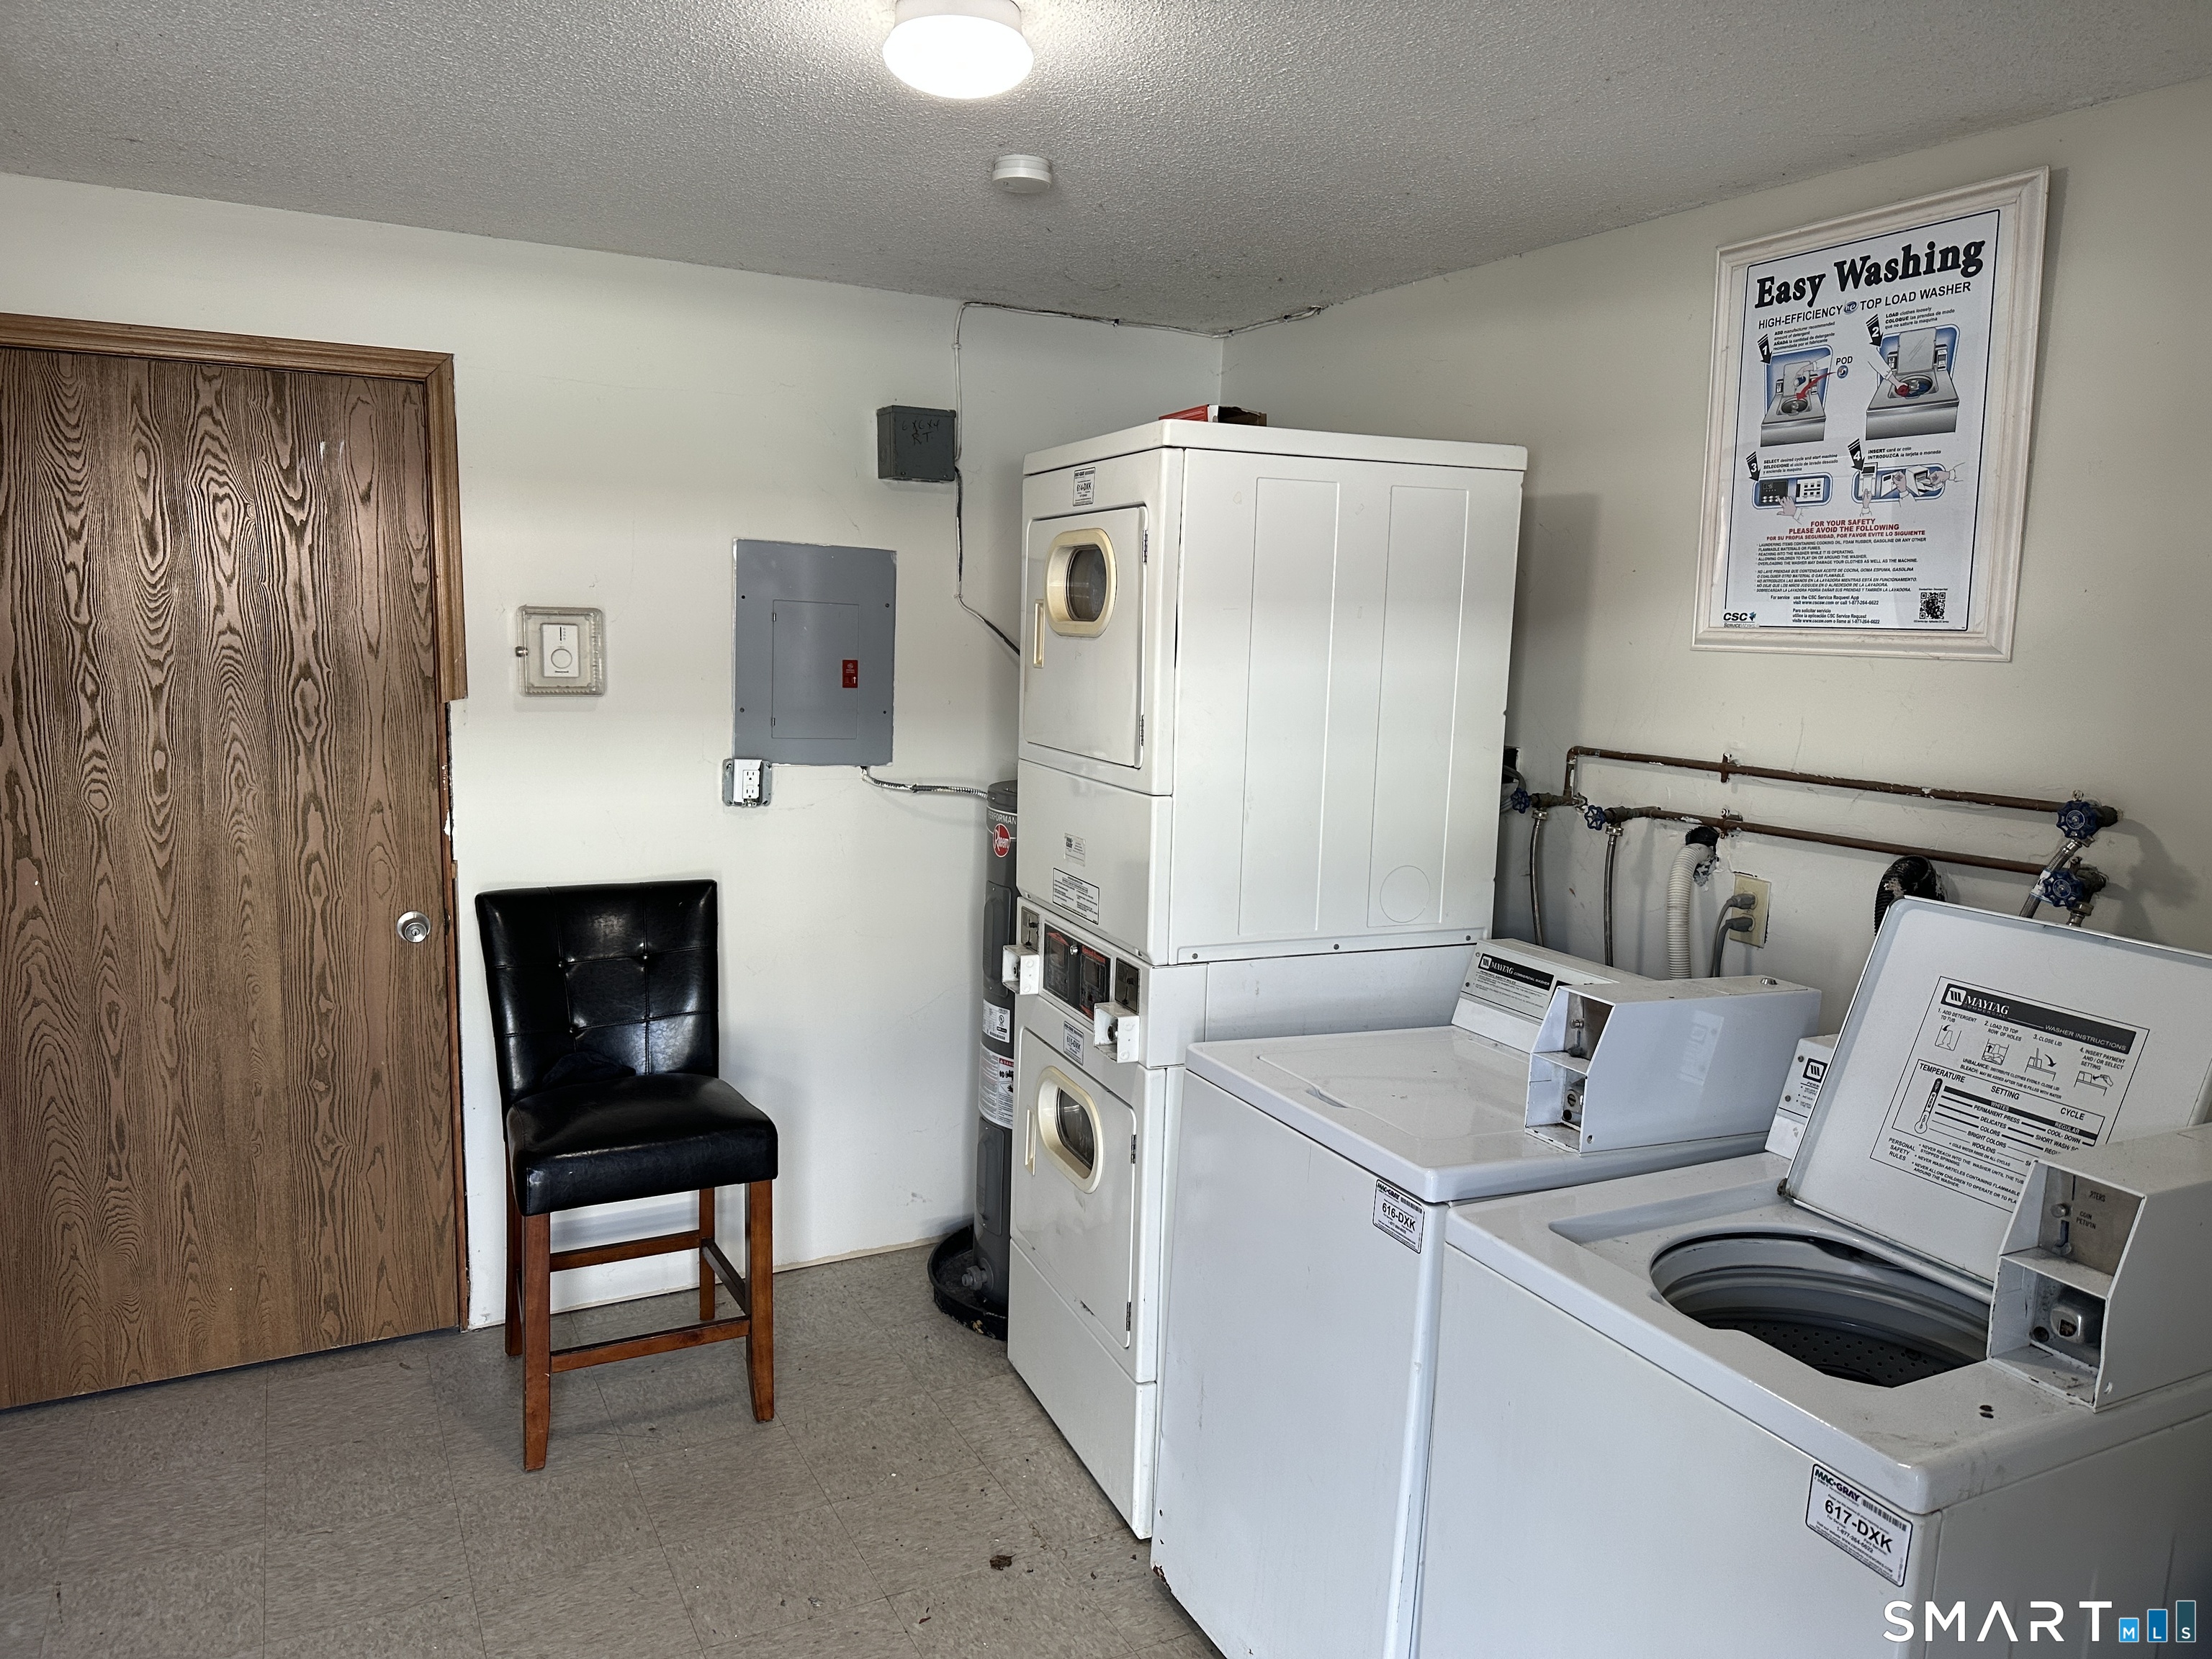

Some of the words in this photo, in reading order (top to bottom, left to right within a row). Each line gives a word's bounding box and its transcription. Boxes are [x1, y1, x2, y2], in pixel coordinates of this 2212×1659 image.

[1755, 273, 1826, 309] Easy
[1833, 240, 1986, 292] Washing
[1758, 305, 1843, 330] HIGH-EFFICIENCY
[1860, 297, 1881, 310] TOP
[1885, 292, 1916, 306] LOAD
[1920, 282, 1971, 300] WASHER
[1871, 326, 1879, 338] 2
[1762, 346, 1767, 355] 1
[1835, 356, 1853, 366] POD
[1853, 451, 1861, 461] 4
[1751, 463, 1757, 472] 3
[1723, 612, 1748, 621] CSC
[1492, 962, 1514, 974] MAYTAG
[1965, 996, 2009, 1015] MAYTAG
[1951, 1012, 1977, 1022] DETERGENT
[2038, 1036, 2054, 1045] CLOSE
[2046, 1025, 2074, 1037] WASHER
[2075, 1033, 2126, 1051] INSTRUCTIONS
[2085, 1049, 2103, 1058] INSERT
[2103, 1054, 2126, 1064] PAYMENT
[2080, 1061, 2101, 1070] SETTING
[2104, 1061, 2124, 1070] SELECT
[1920, 1063, 1966, 1083] TEMPERATURE
[1991, 1086, 2020, 1100] SETTING
[1991, 1102, 2009, 1111] WHITES
[1974, 1105, 2003, 1118] PERMANENT
[2003, 1115, 2020, 1124] PRESS
[2060, 1107, 2085, 1120] CYCLE
[1980, 1116, 2007, 1129] DELICATES
[2054, 1122, 2080, 1134] REGULAR
[1980, 1125, 2000, 1137] COLORS
[1888, 1137, 1915, 1151] PERSONAL
[1967, 1130, 1986, 1141] BRIGHT
[1986, 1137, 2007, 1148] COLORS
[2035, 1135, 2053, 1145] SHORT
[2064, 1134, 2081, 1144] DOWN
[1890, 1144, 1910, 1155] SAFETY
[1920, 1148, 1940, 1159] STOPPED
[1972, 1141, 1996, 1154] WOOLENS
[1889, 1151, 1906, 1161] RULES
[1936, 1149, 1951, 1158] REACH
[1972, 1163, 1991, 1172] WASHER
[1913, 1167, 1931, 1177] AROUND
[1915, 1162, 1929, 1171] NEVER
[1928, 1168, 1944, 1177] ALLOW
[1944, 1174, 1966, 1184] CHILDREN
[1972, 1184, 1993, 1195] OPERATE
[1944, 1166, 1966, 1176] ARTICLES
[1966, 1173, 1992, 1186] CONTAINING
[1992, 1183, 2020, 1197] FLAMMABLE
[1382, 1202, 1416, 1231] 616-DXK
[1825, 1500, 1893, 1553] 617-DXK
